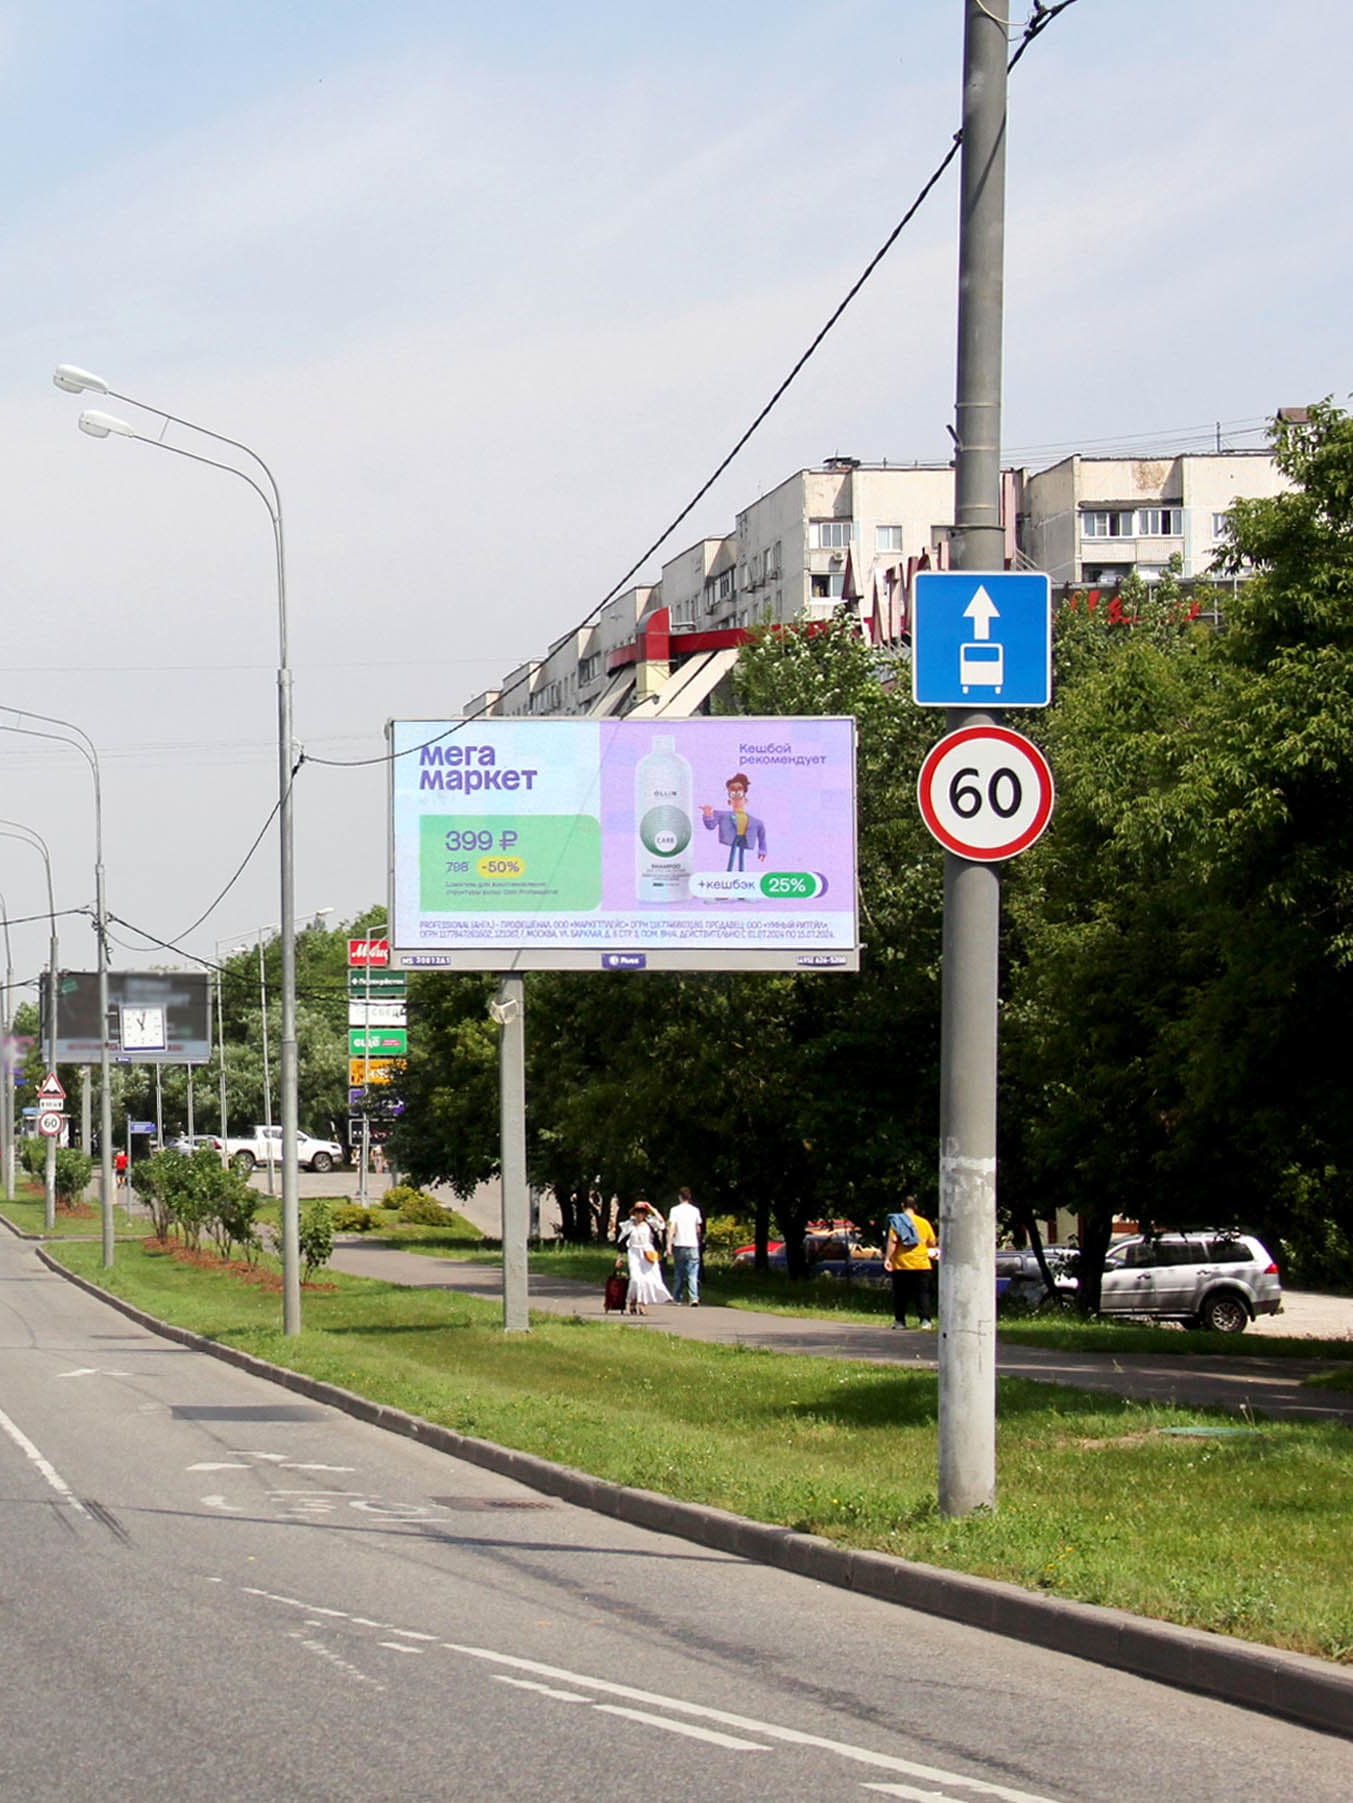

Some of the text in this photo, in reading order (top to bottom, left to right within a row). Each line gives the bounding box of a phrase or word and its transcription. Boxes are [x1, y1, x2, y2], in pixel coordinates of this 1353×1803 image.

[419, 745, 496, 766] мега
[739, 743, 792, 753] Кешбой
[739, 756, 826, 766] рекомендует
[419, 769, 538, 795] маркет
[949, 767, 1022, 819] 60
[445, 830, 493, 851] 399
[481, 861, 520, 872] -50%
[768, 877, 806, 893] 25%
[43, 1118, 58, 1128] 60
